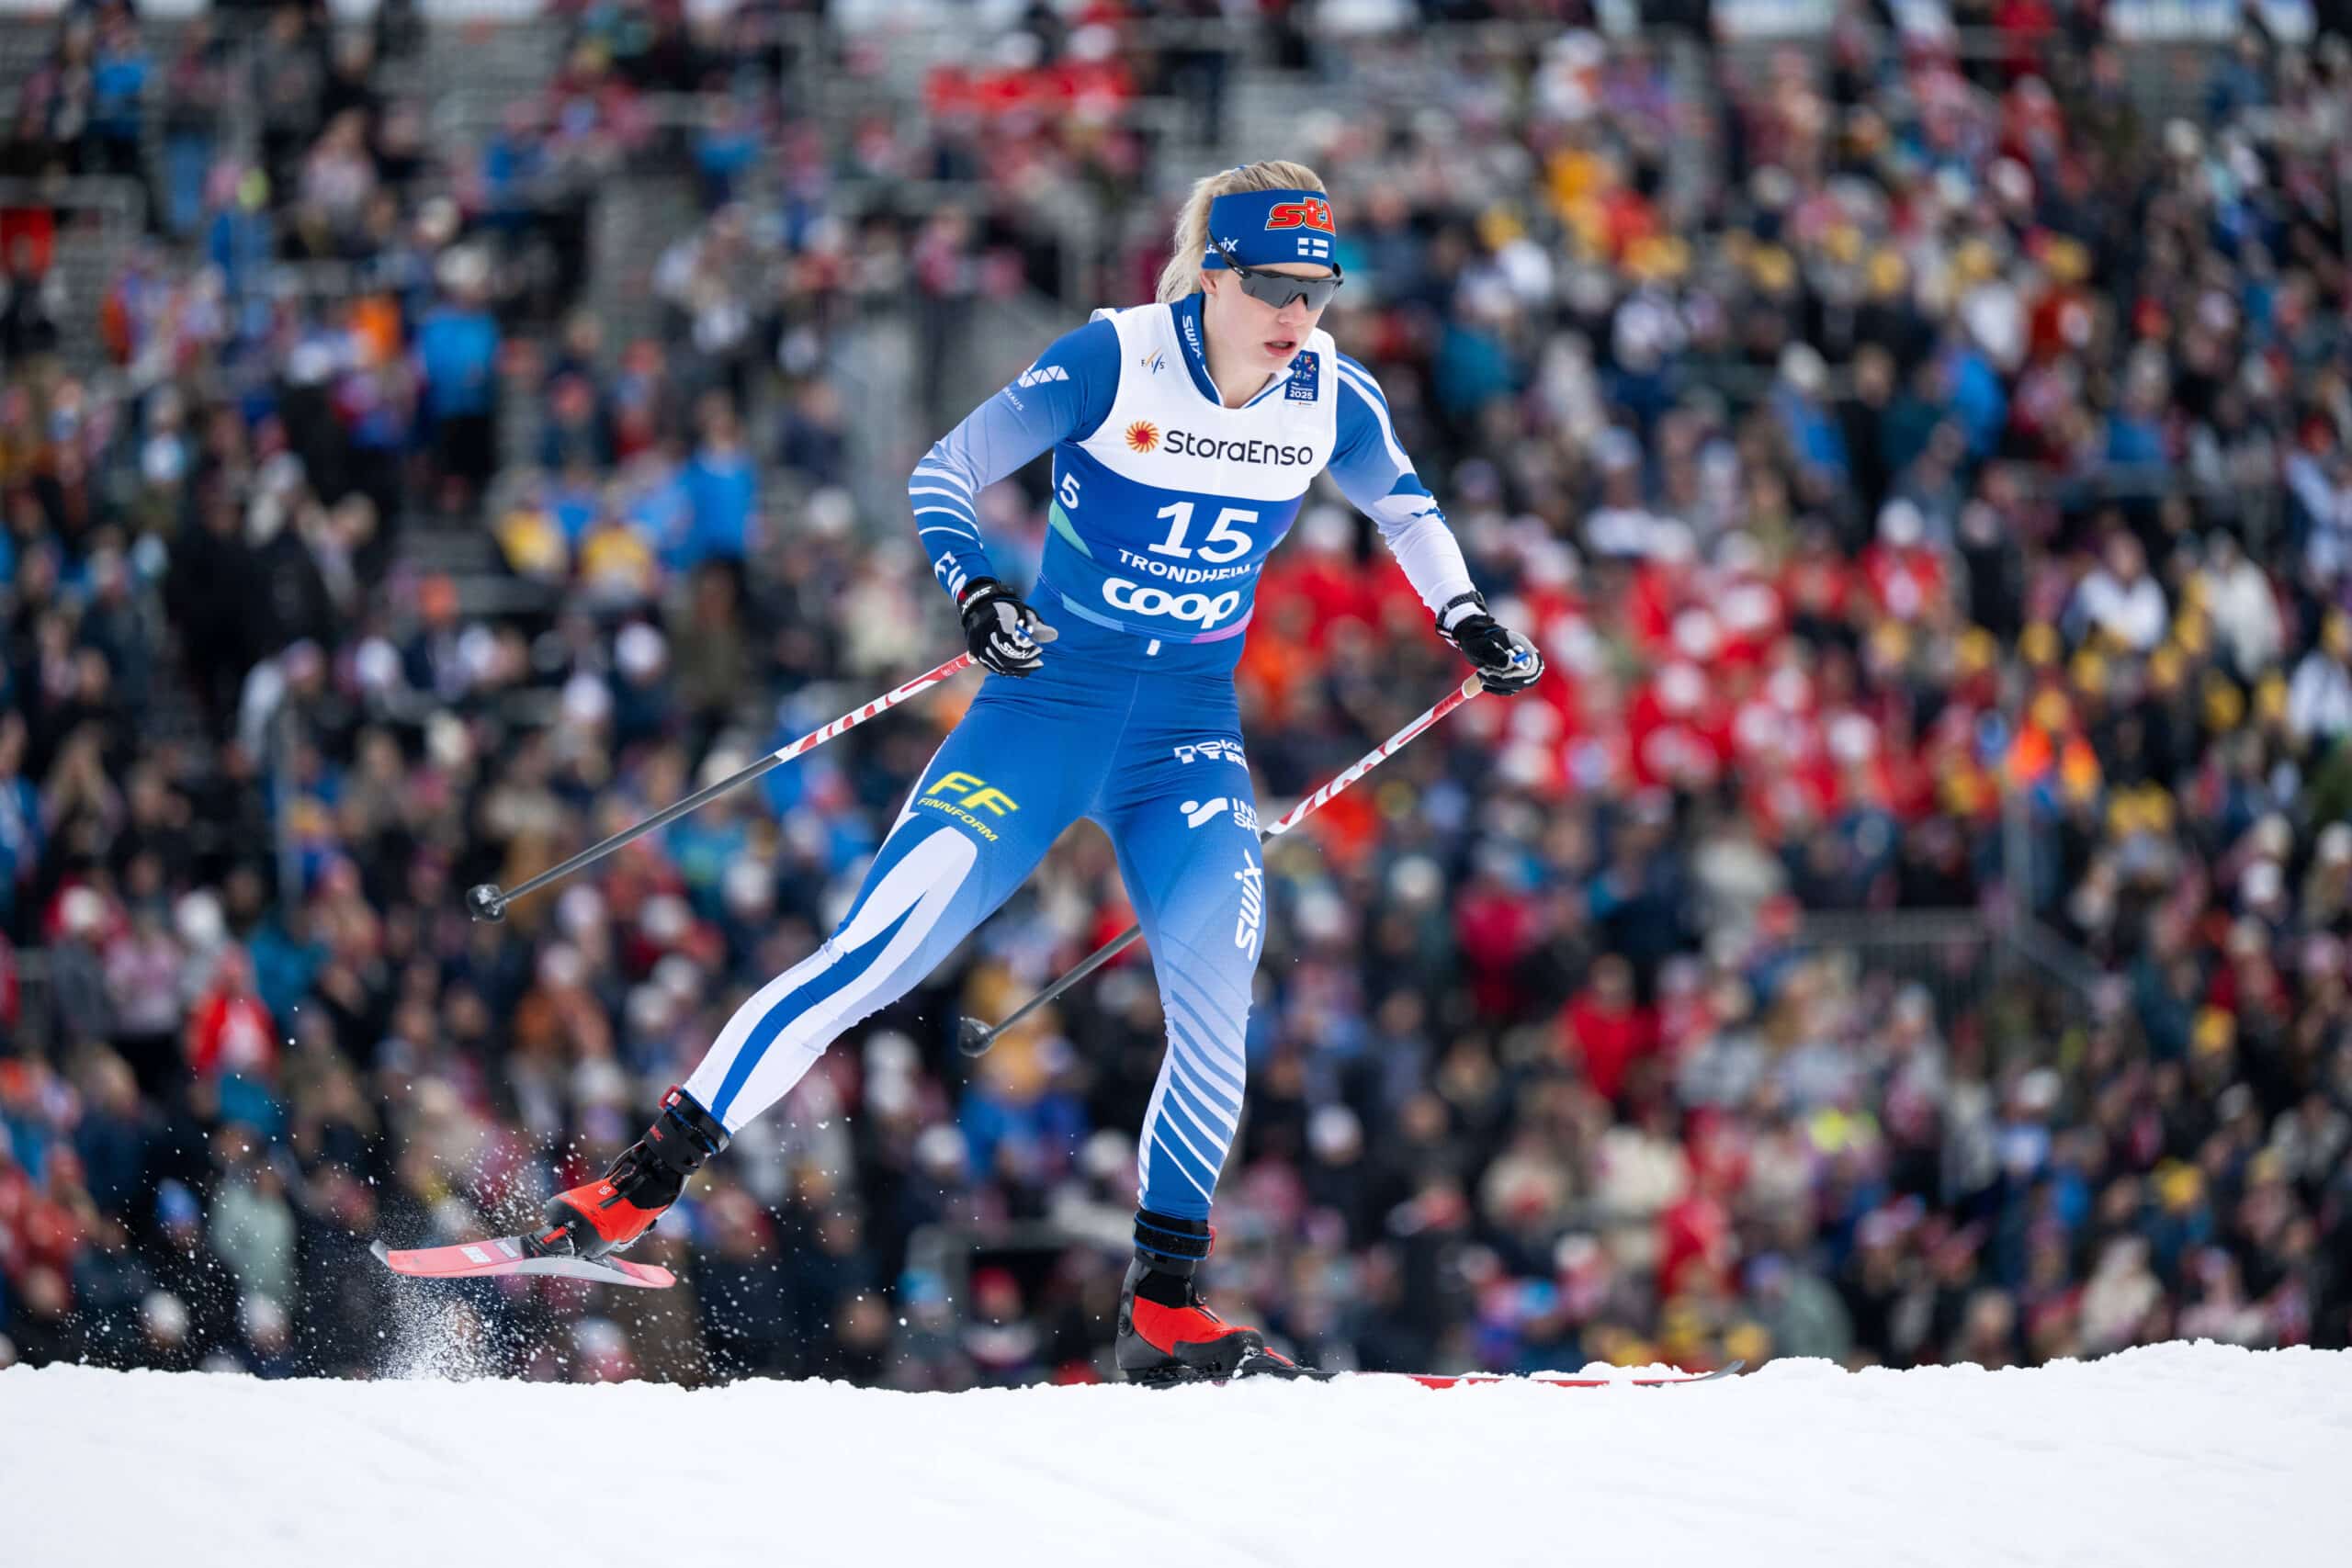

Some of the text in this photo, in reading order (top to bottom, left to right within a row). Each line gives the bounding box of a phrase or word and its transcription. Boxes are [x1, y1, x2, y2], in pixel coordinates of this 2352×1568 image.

[1289, 389, 1314, 400] 2025
[1163, 430, 1314, 466] StoraEnso
[1148, 501, 1259, 563] 15
[1118, 548, 1250, 584] TRONDHEIM
[925, 771, 1020, 816] FF
[918, 797, 999, 842] FINNFORM
